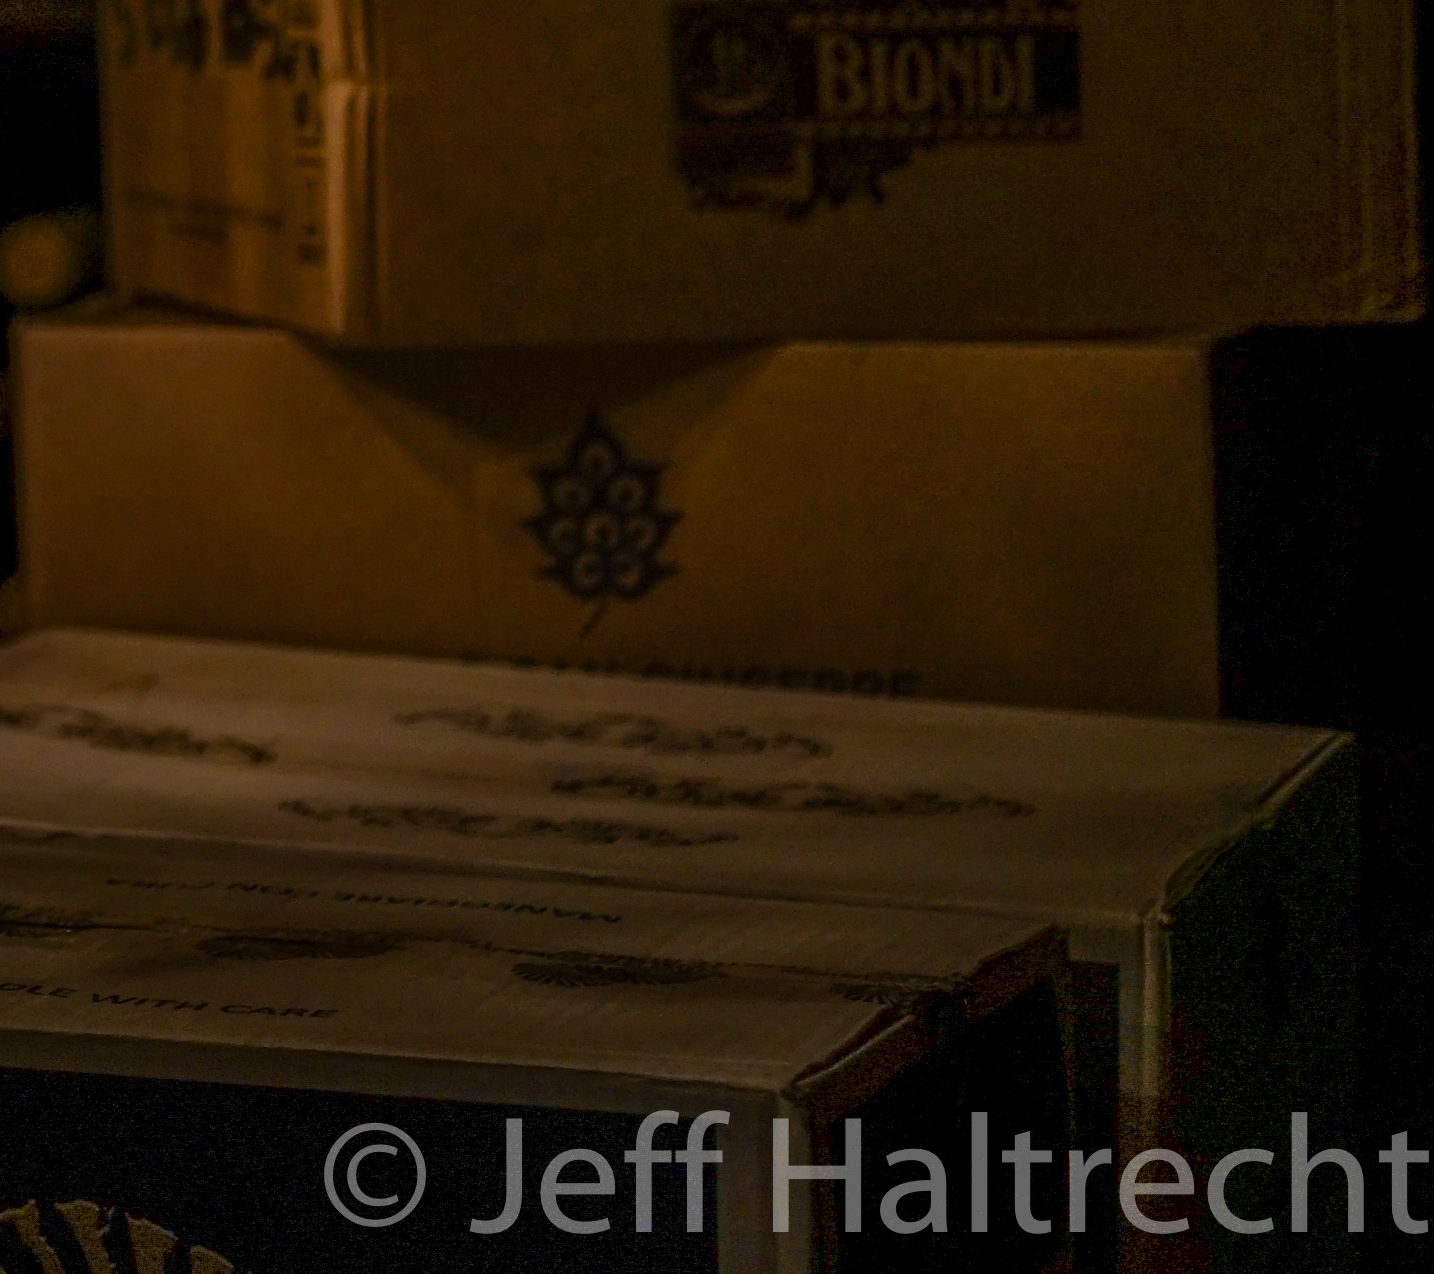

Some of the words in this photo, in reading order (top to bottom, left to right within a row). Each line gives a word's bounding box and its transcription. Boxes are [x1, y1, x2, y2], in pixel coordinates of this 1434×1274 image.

[816, 34, 1036, 113] BIONDI
[90, 992, 210, 1013] WITH
[220, 1003, 339, 1020] CARE
